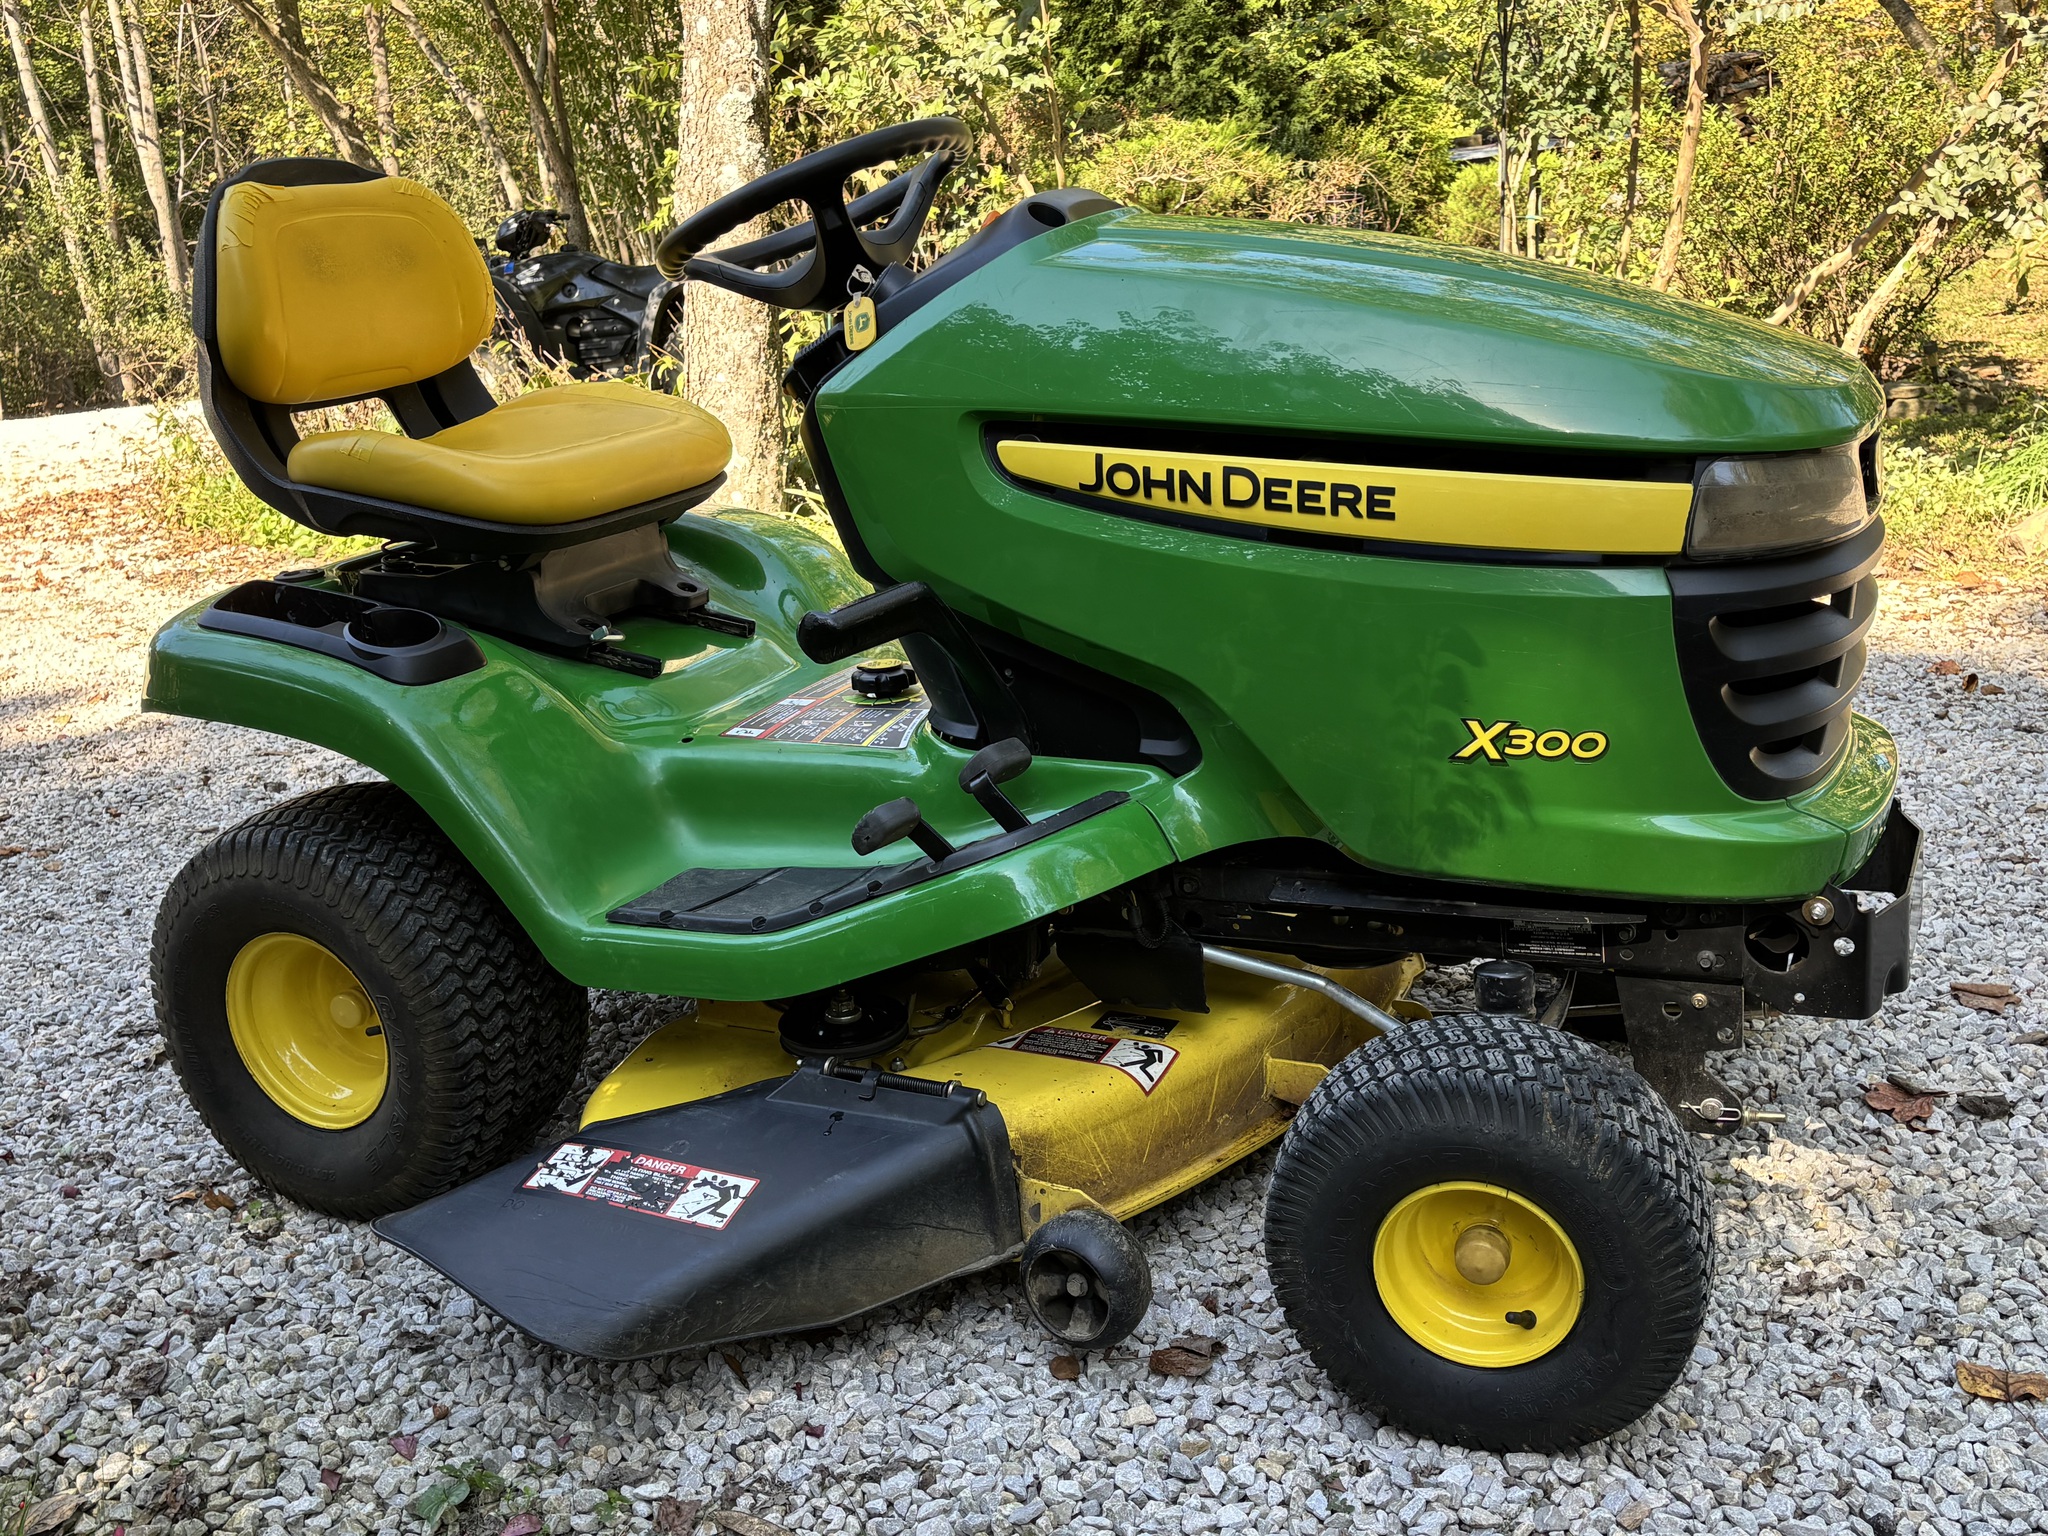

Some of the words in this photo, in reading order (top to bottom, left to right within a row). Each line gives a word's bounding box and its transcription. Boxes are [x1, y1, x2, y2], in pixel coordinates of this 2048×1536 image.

[1079, 453, 1212, 505] JOHN
[1222, 465, 1396, 521] DEERE
[1449, 718, 1609, 764] X300
[1057, 1029, 1107, 1041] DANGER
[365, 994, 411, 1175] CARLISLE
[635, 1157, 687, 1174] DANGER
[502, 1198, 526, 1210] DO
